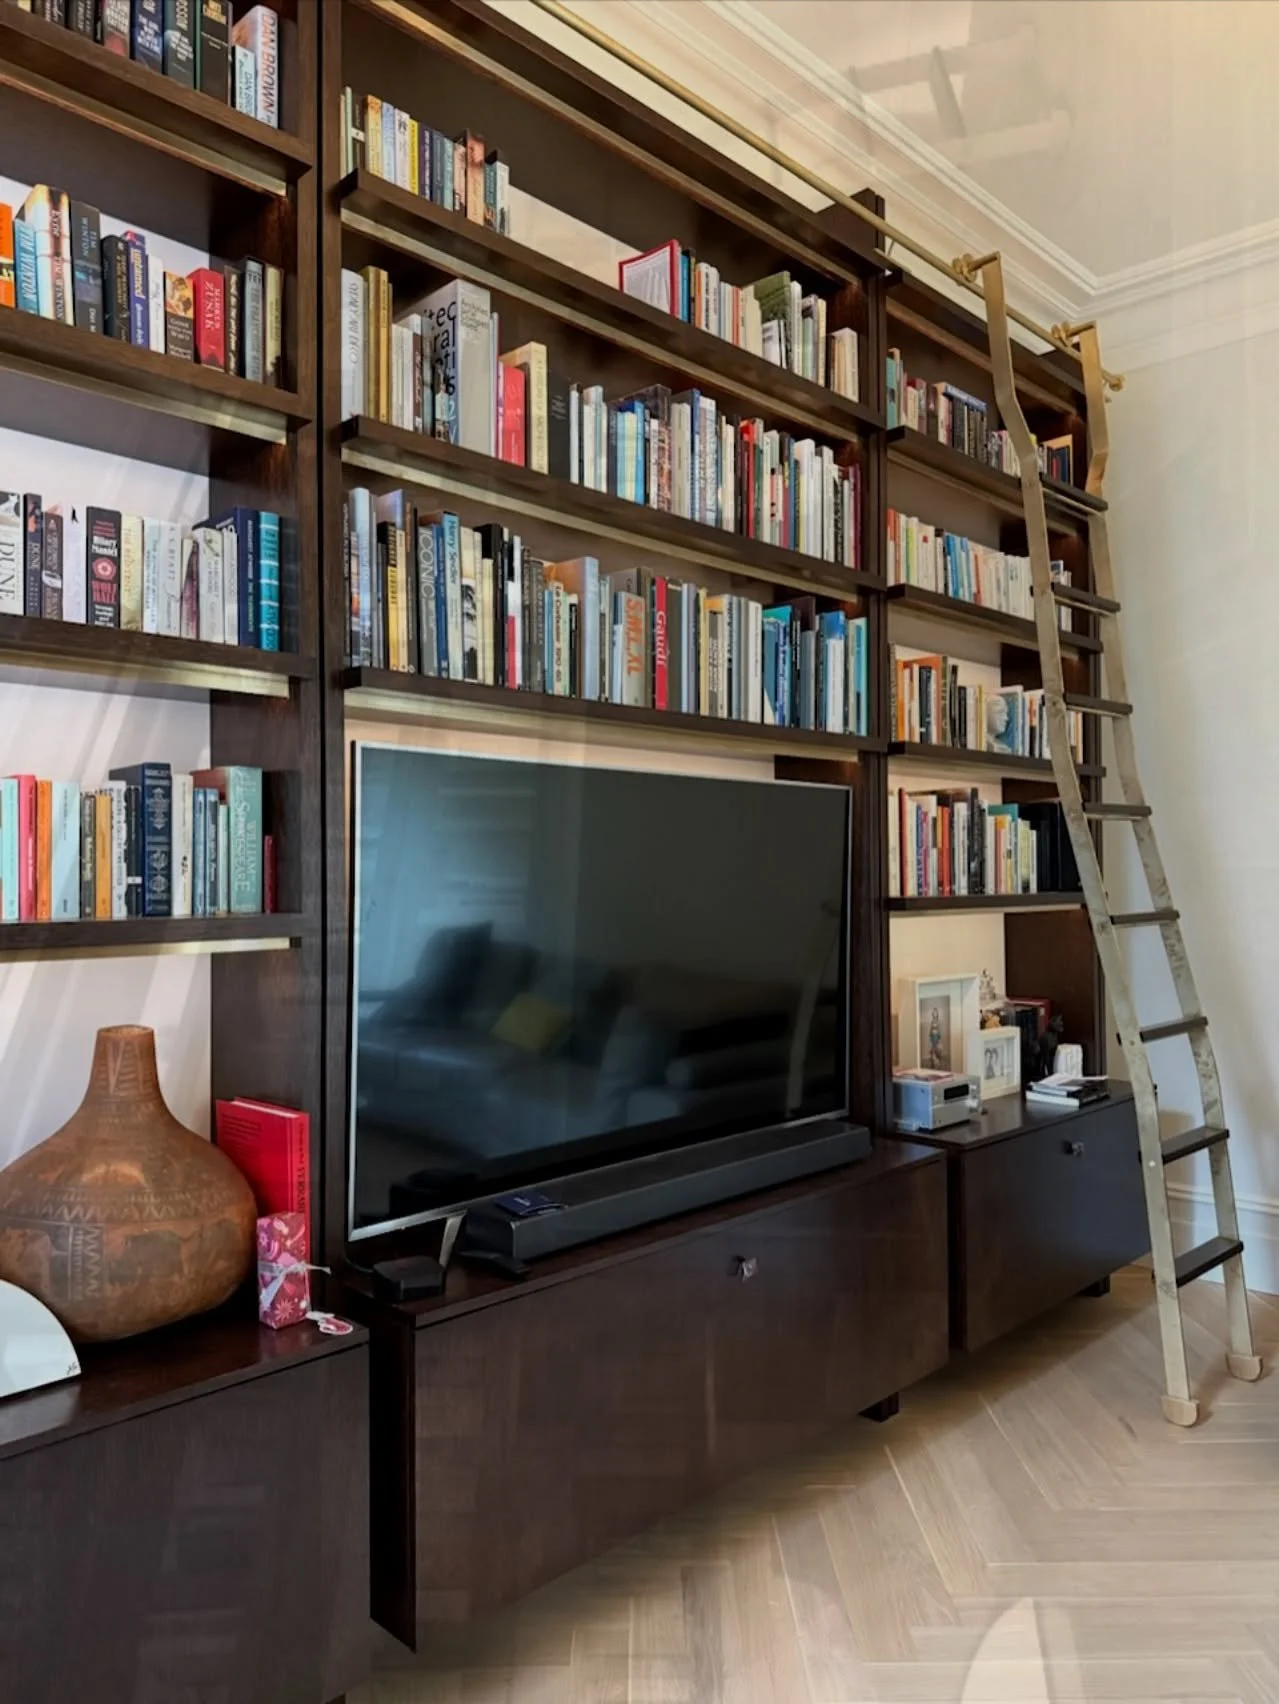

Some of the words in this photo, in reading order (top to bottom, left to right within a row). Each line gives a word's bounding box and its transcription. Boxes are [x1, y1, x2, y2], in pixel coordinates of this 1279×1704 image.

[261, 14, 277, 48] DAN
[261, 50, 276, 114] BROWN
[19, 226, 35, 249] TIM
[81, 217, 90, 257] WINTON
[19, 252, 37, 301] WINTON
[130, 248, 146, 299] untamed
[55, 278, 65, 319] WINTON
[205, 280, 215, 330] ZUSAK
[29, 543, 41, 570] DUNE
[447, 519, 457, 549] Harry
[0, 542, 16, 601] DUNE
[419, 528, 435, 598] ICONIC
[449, 551, 459, 585] Seidler
[235, 800, 250, 892] SHAKESPEARE
[246, 819, 257, 874] WILLIAM
